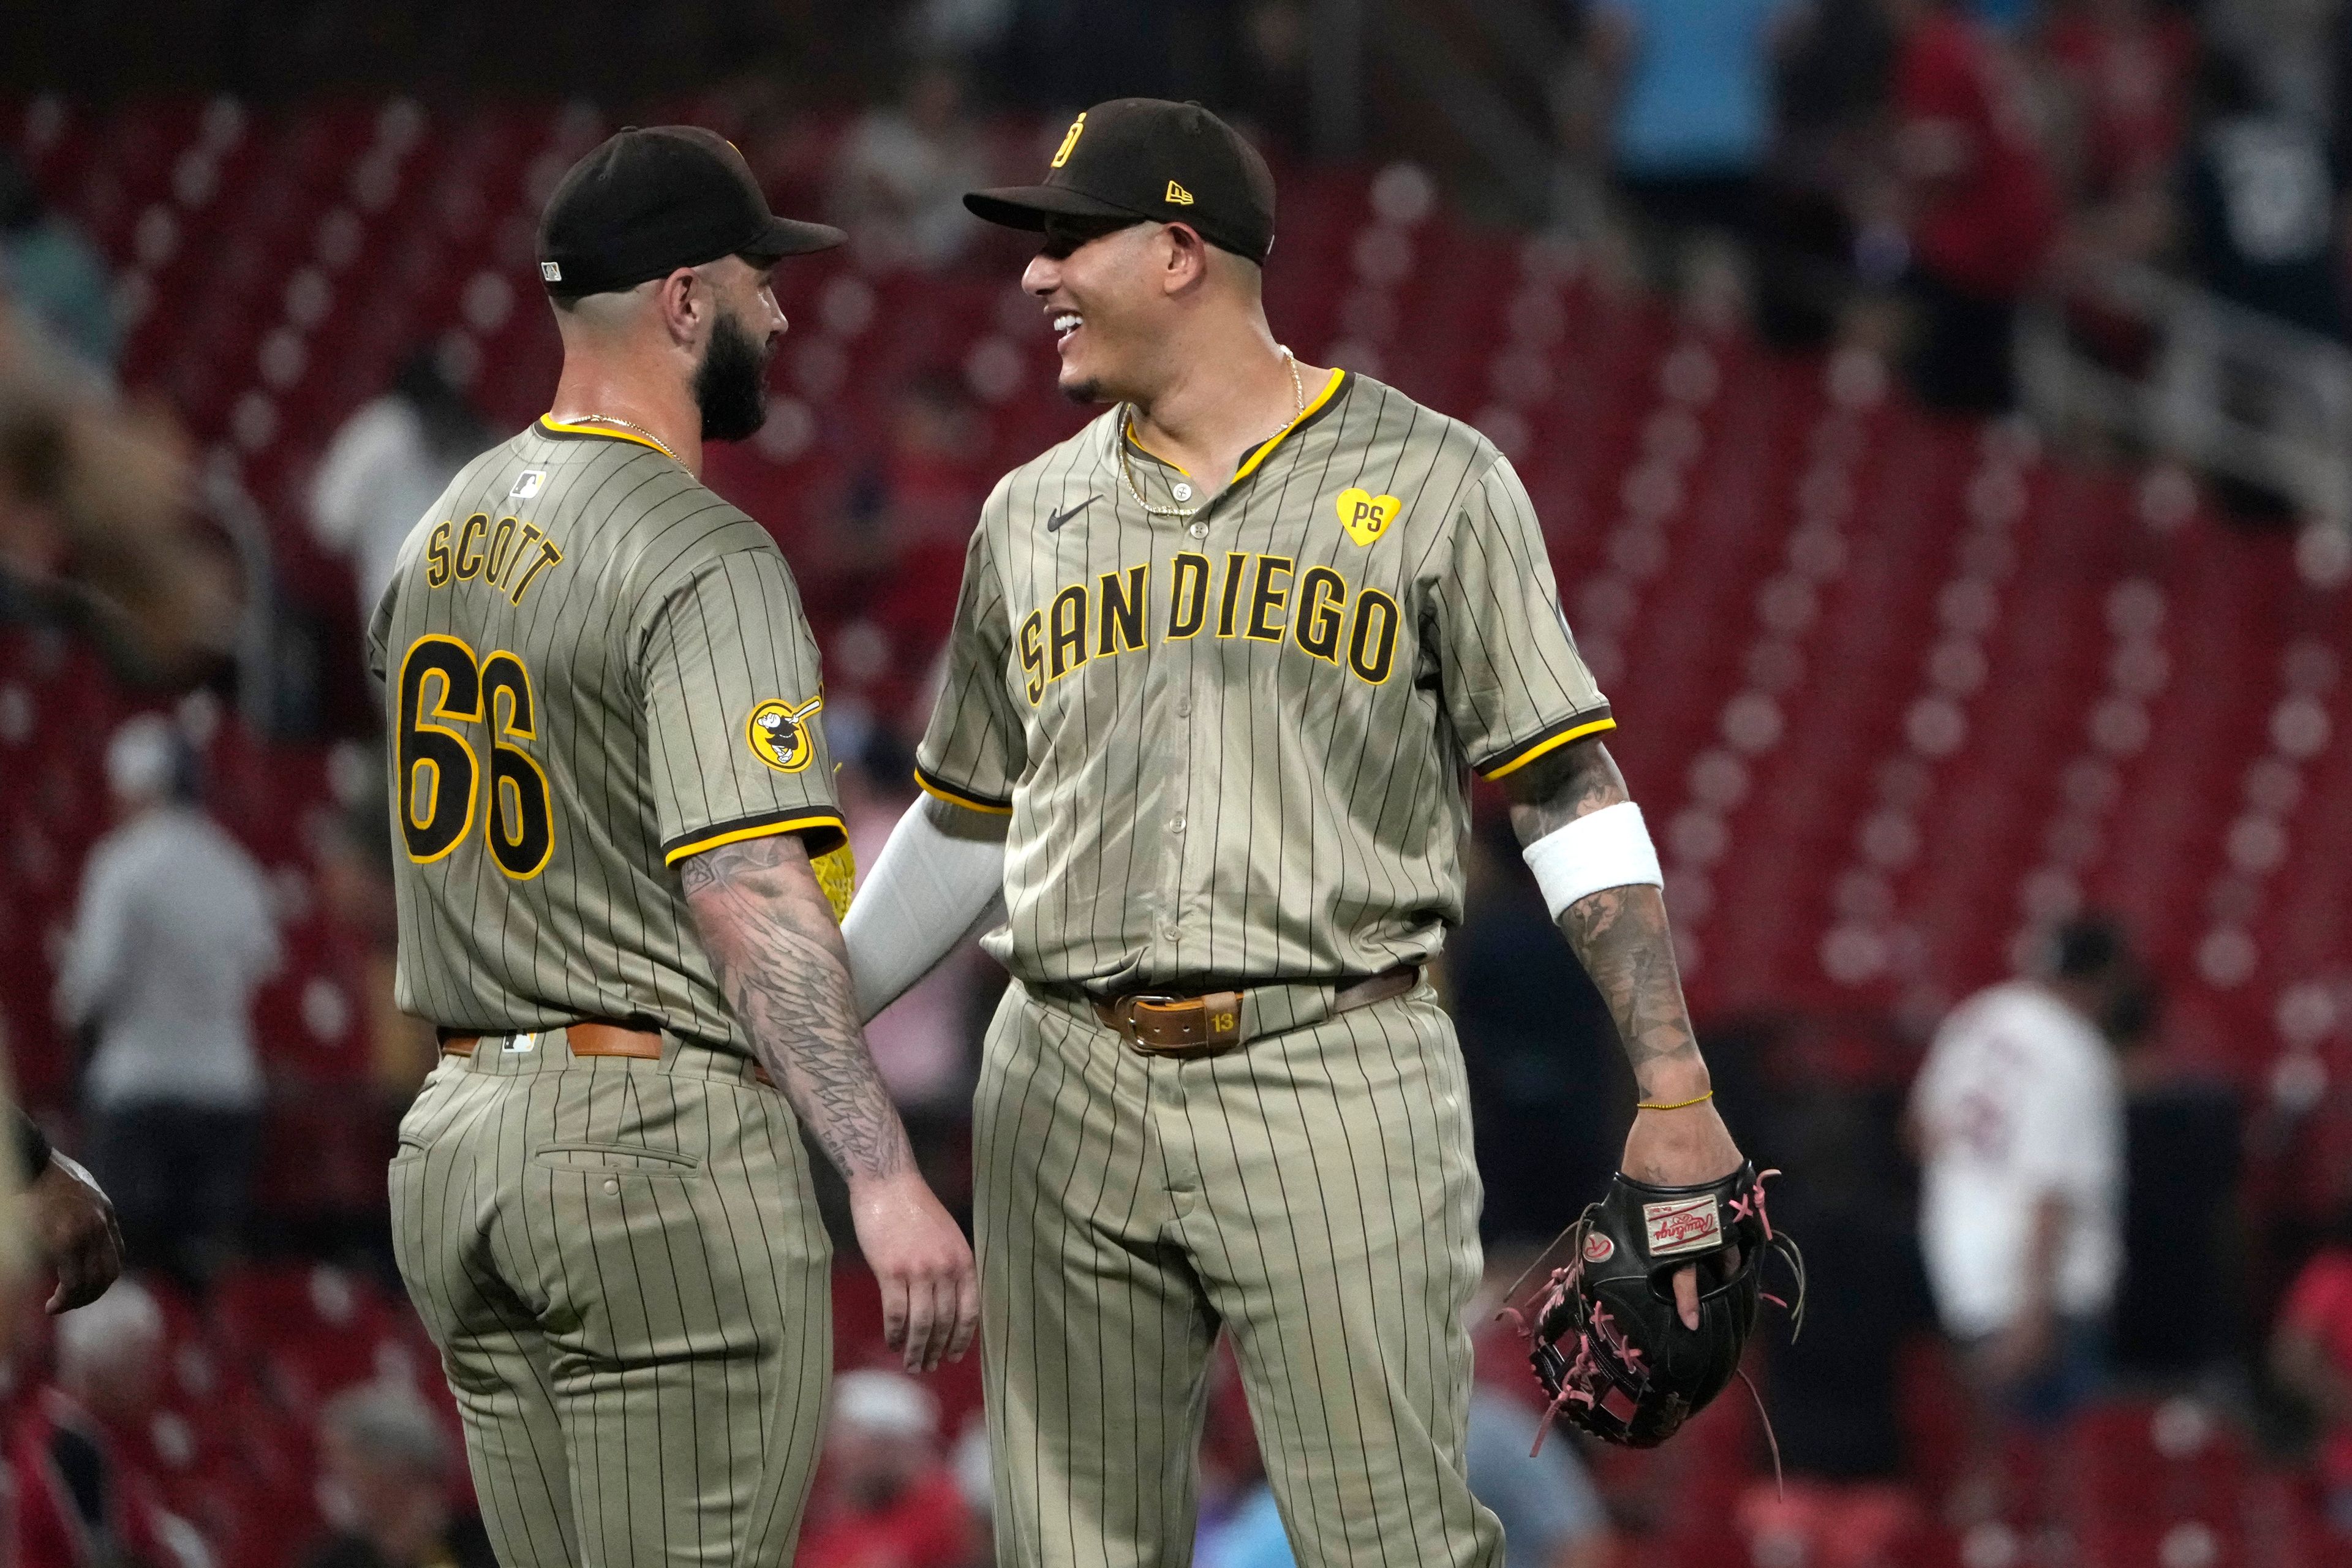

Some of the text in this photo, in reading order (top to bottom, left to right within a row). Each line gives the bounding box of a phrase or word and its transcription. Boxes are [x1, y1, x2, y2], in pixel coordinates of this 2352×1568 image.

[1351, 502, 1384, 532] PS
[426, 513, 563, 606] SCOTT
[1019, 551, 1401, 707] SAN DIEGO
[398, 633, 554, 880] 66
[1211, 1013, 1234, 1033] 13
[1653, 1213, 1713, 1240] Rawlings
